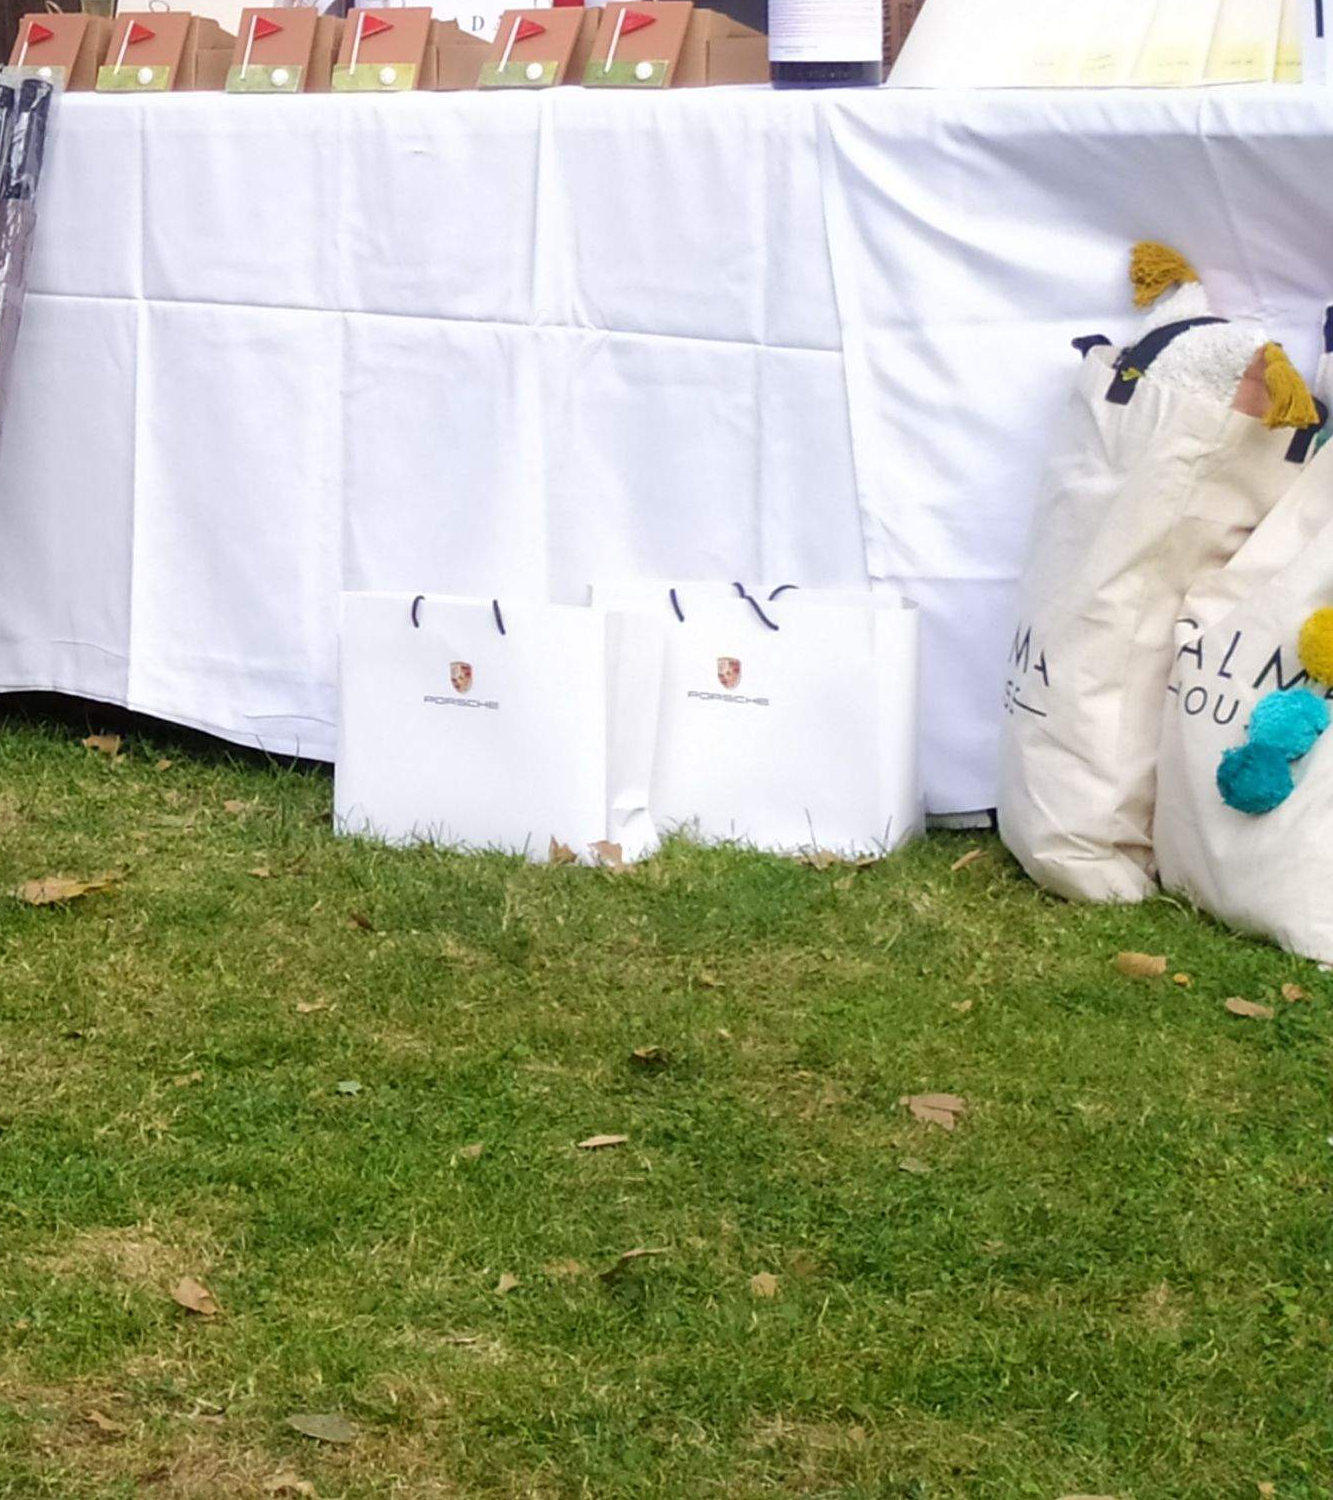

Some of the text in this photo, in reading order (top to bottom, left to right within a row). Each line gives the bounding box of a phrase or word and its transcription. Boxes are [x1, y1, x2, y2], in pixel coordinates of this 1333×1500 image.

[1176, 630, 1311, 692] ALM
[424, 695, 499, 710] PORSCHE
[687, 689, 770, 706] PORSCHE
